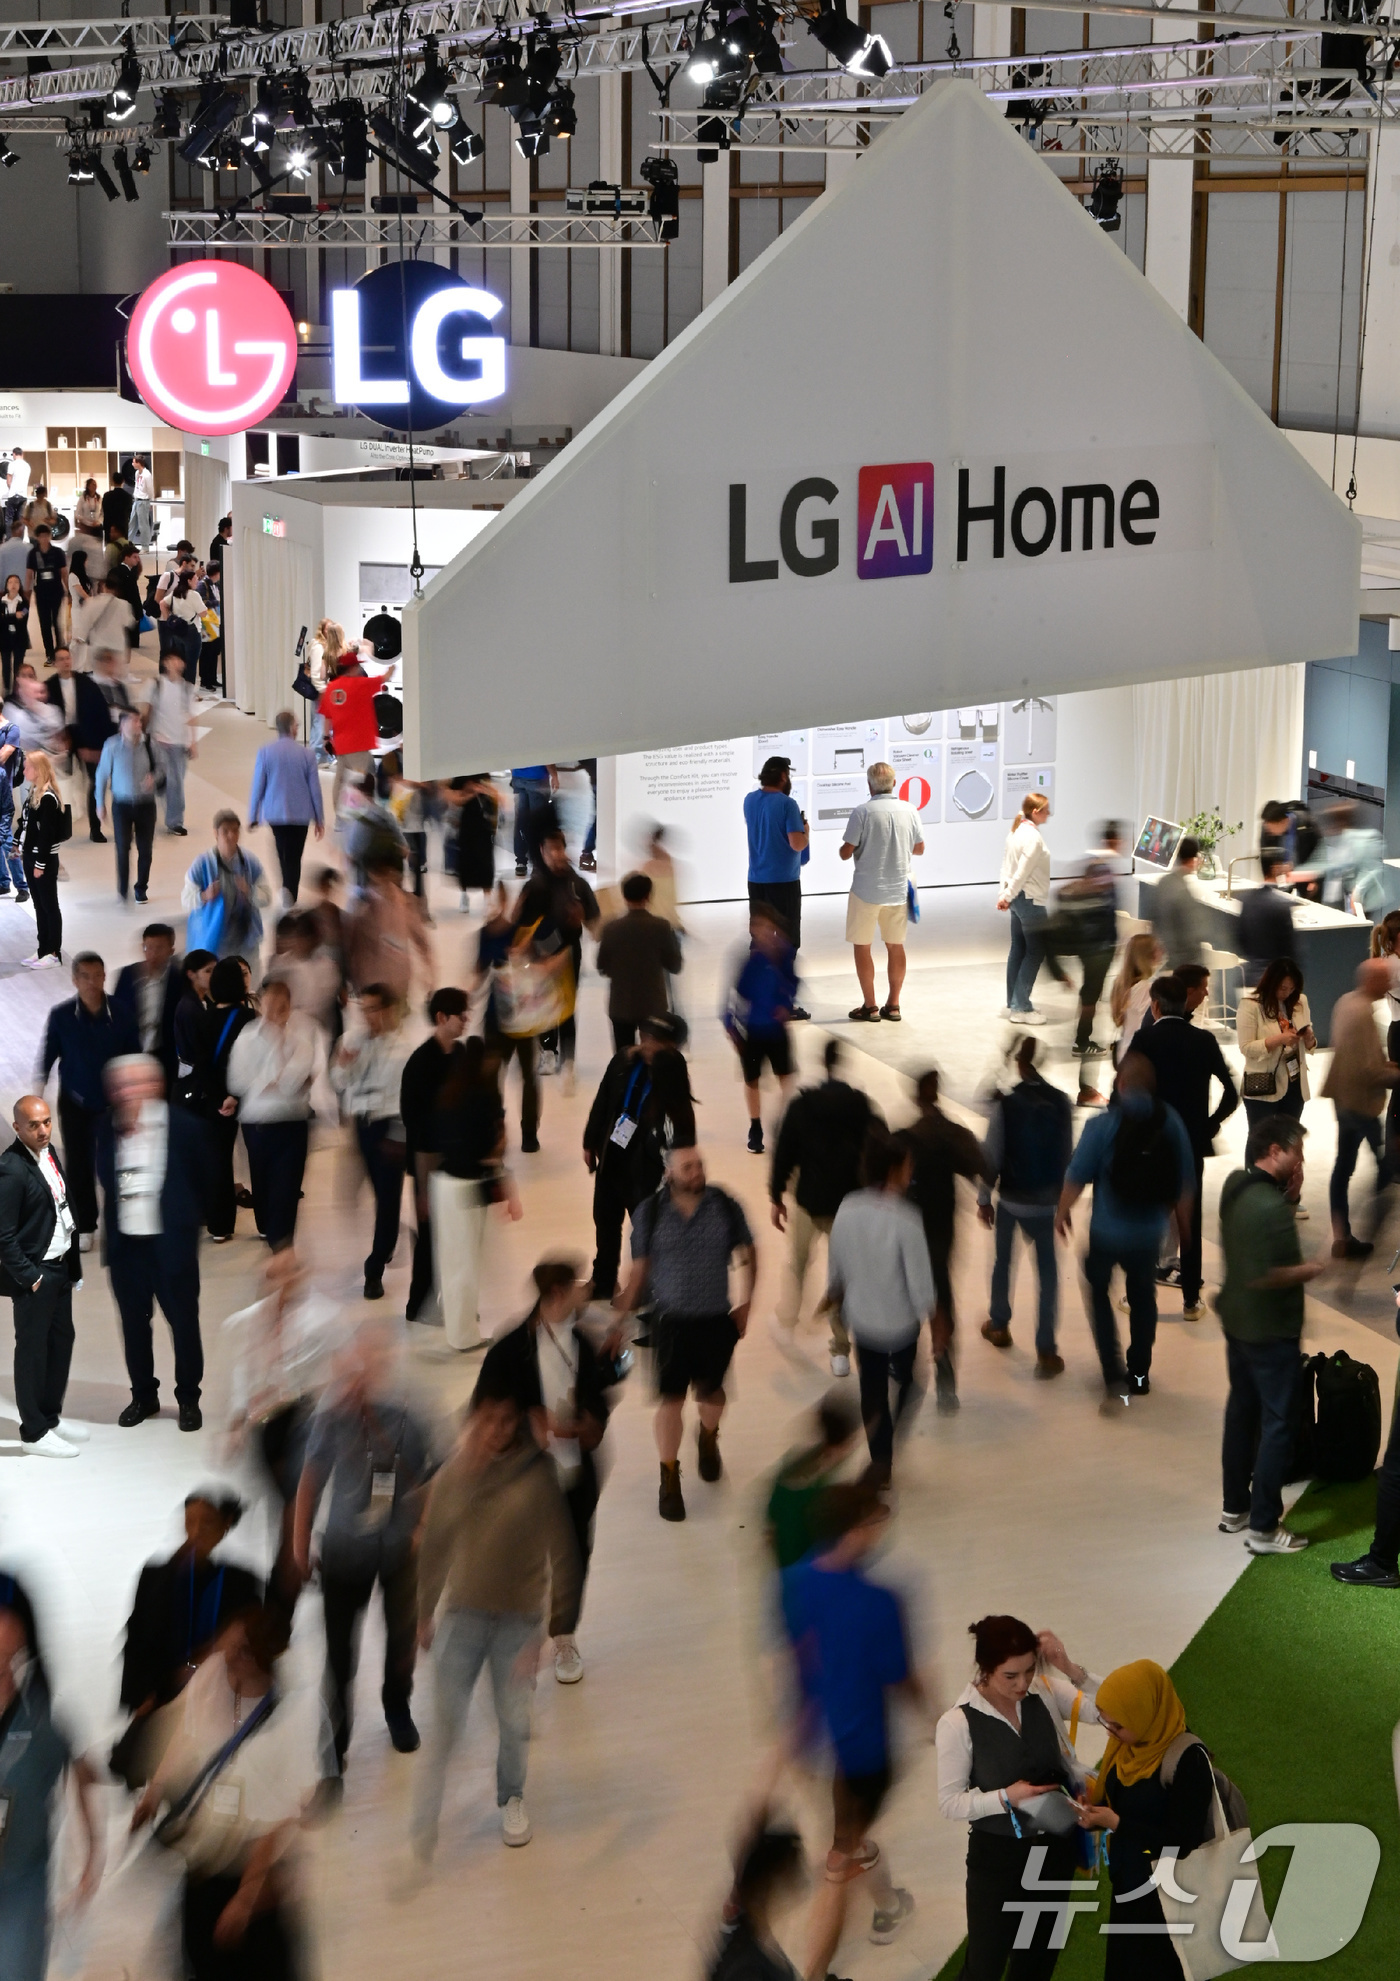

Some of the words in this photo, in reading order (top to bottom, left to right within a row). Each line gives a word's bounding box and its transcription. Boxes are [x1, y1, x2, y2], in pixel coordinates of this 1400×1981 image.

[332, 287, 505, 404] LG
[360, 442, 368, 450] LG
[369, 443, 384, 451] DUAL
[385, 444, 405, 453] Inverter
[729, 477, 840, 583] LG
[863, 482, 924, 561] AI
[957, 465, 1161, 563] Home
